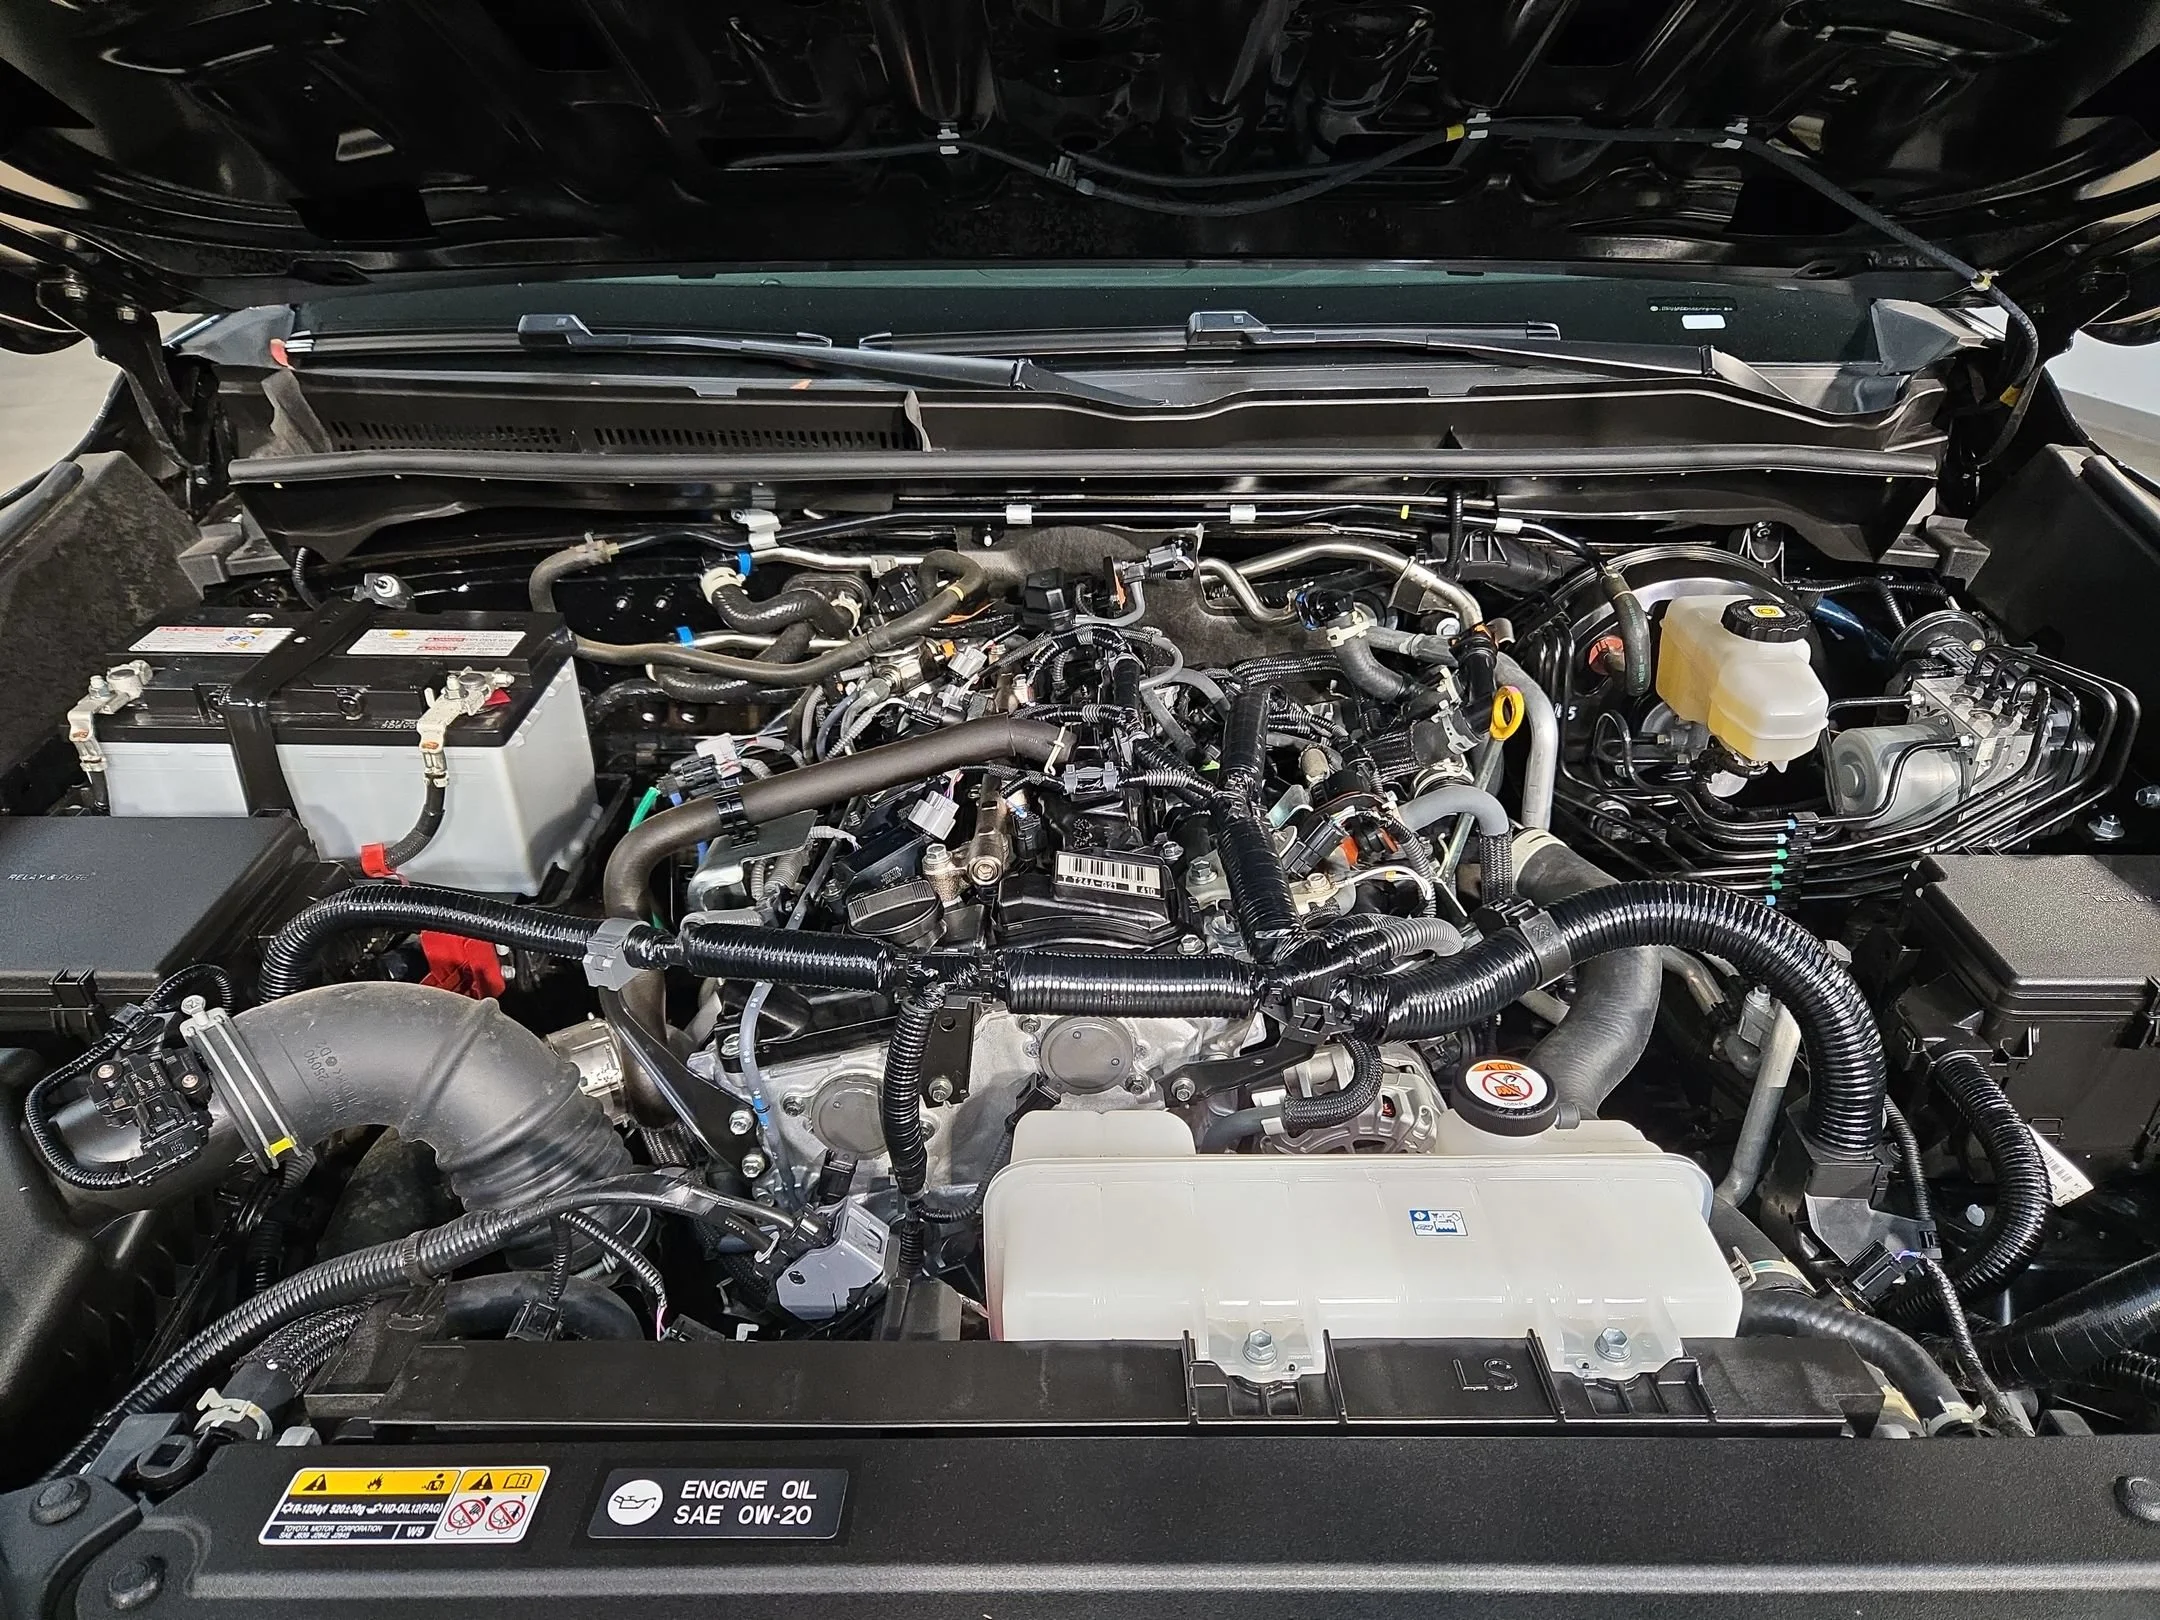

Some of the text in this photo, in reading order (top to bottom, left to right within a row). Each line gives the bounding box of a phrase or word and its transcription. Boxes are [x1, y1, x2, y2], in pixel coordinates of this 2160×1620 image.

[1140, 887, 1156, 896] 410
[1453, 1358, 1519, 1391] LS
[681, 1480, 817, 1499] ENGINE OIL
[673, 1505, 812, 1525] SAE 0W-20
[283, 1525, 383, 1533] TOYOTA MOTOR CORPORATION
[406, 1526, 425, 1538] W9
[279, 1532, 294, 1540] SAE
